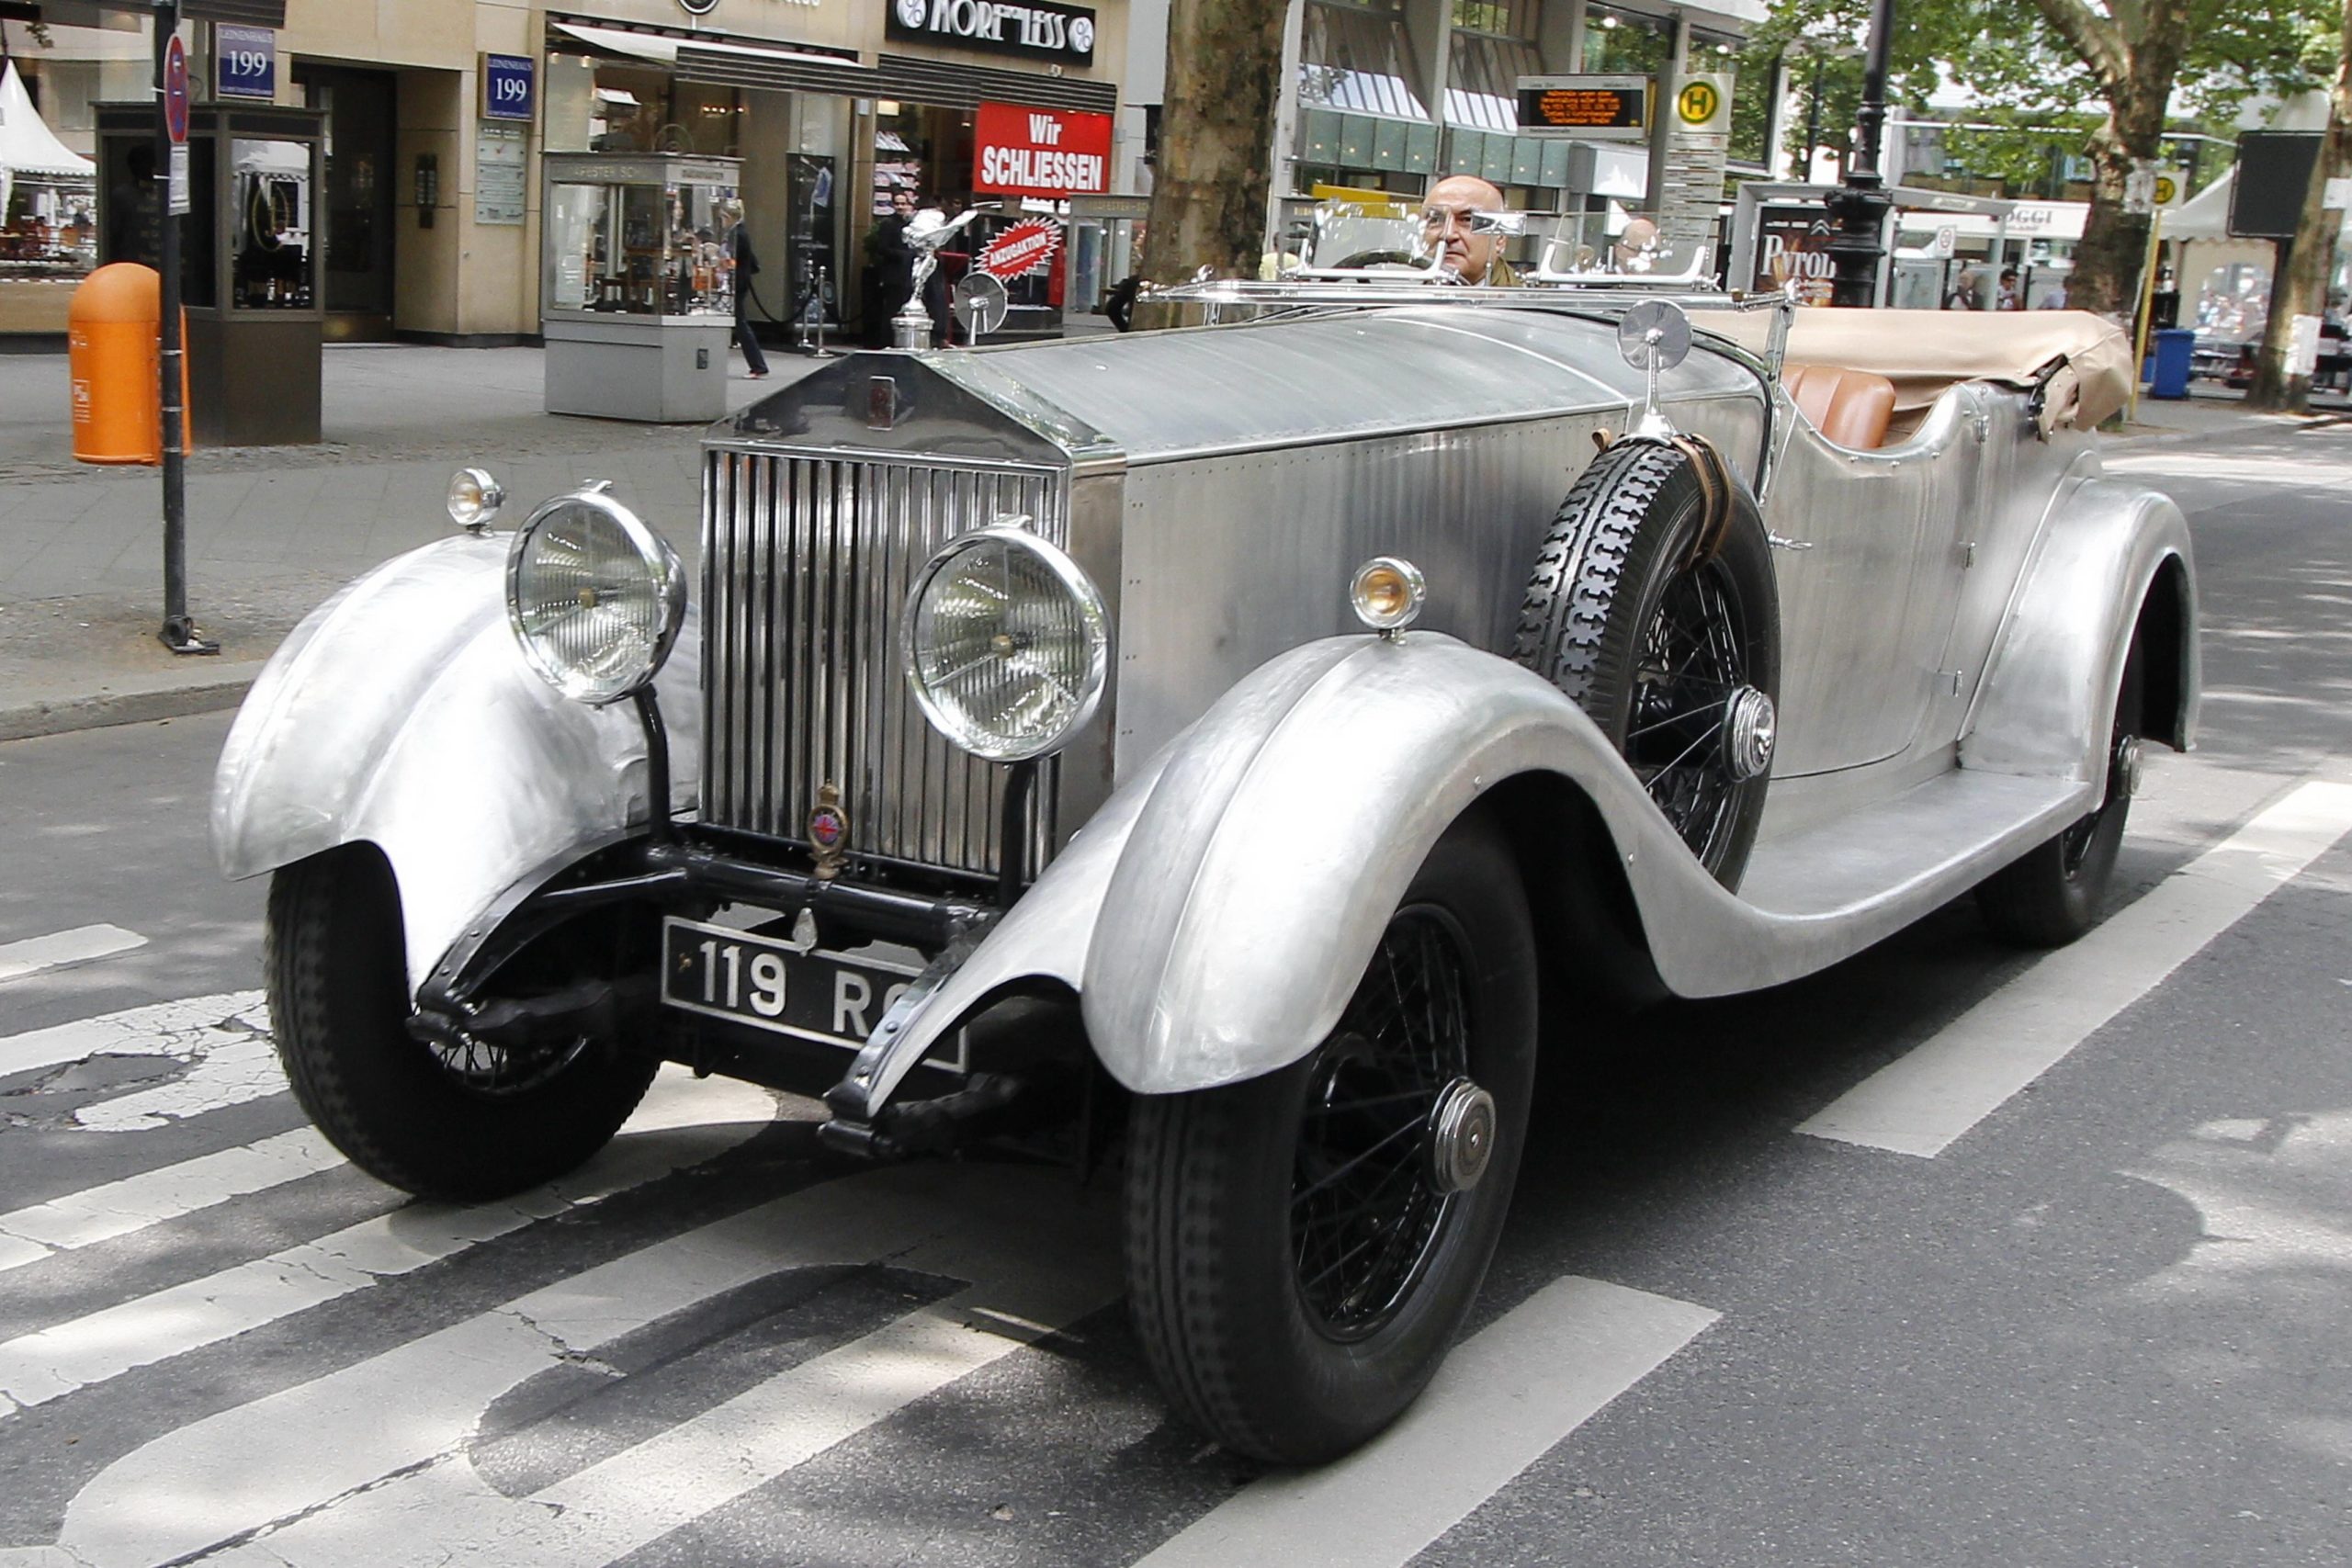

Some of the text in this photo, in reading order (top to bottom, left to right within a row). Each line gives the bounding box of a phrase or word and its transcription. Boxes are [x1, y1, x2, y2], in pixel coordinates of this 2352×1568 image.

[930, 0, 1004, 41] MORE
[1020, 8, 1067, 50] LESS
[229, 50, 266, 77] 199
[495, 77, 526, 102] 199
[1688, 91, 1708, 115] H
[1028, 113, 1062, 145] Wir
[981, 145, 1102, 191] SCHLIESSEN
[700, 942, 786, 1017] 119
